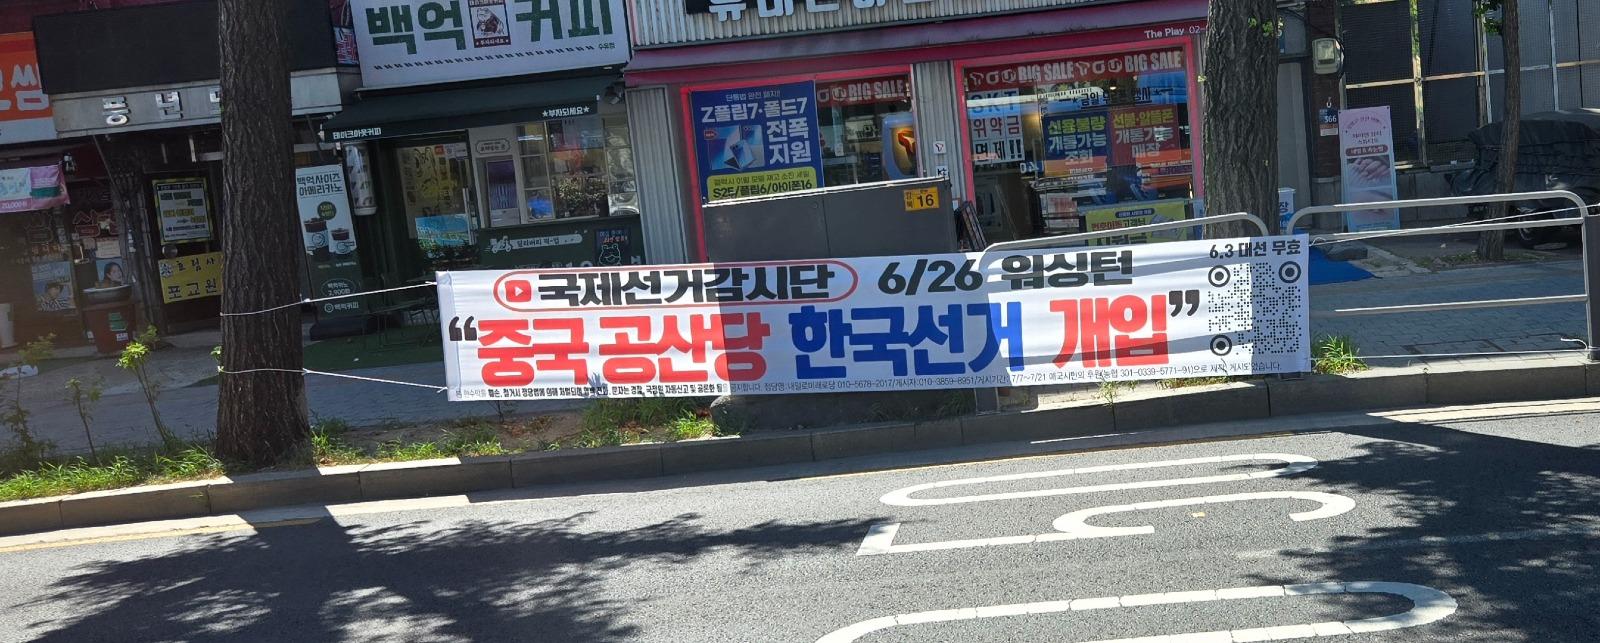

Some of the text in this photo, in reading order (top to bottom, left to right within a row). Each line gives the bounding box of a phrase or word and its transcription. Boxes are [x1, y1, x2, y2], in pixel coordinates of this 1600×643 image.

[366, 2, 466, 55] 백억
[516, 0, 613, 42] 커피
[1143, 29, 1162, 38] The
[1164, 27, 1184, 37] Play
[1018, 61, 1074, 82] BIG SALE
[1123, 51, 1182, 72] BIG SALE
[848, 80, 904, 101] BIG SALE
[548, 106, 584, 118] 부자되세요
[332, 127, 382, 140] 테이크아웃커피
[766, 117, 809, 143] 전폭
[973, 115, 1020, 138] 위약금
[1048, 115, 1106, 136] 신용불량
[768, 141, 812, 165] 지원
[1048, 132, 1107, 154] 개통가능
[297, 174, 341, 185] 백억사이즈
[299, 183, 343, 196] 아메리카노
[916, 193, 934, 208] 16
[1209, 238, 1302, 260] 6.3 대선 무효
[878, 249, 1134, 296] 6/26 워싱턴
[538, 263, 837, 307] 국제선거감시단
[599, 309, 771, 384] 공산당
[787, 299, 1025, 380] 한국선거
[1048, 289, 1200, 370] 개입”
[1048, 369, 1085, 380] 애국시민의
